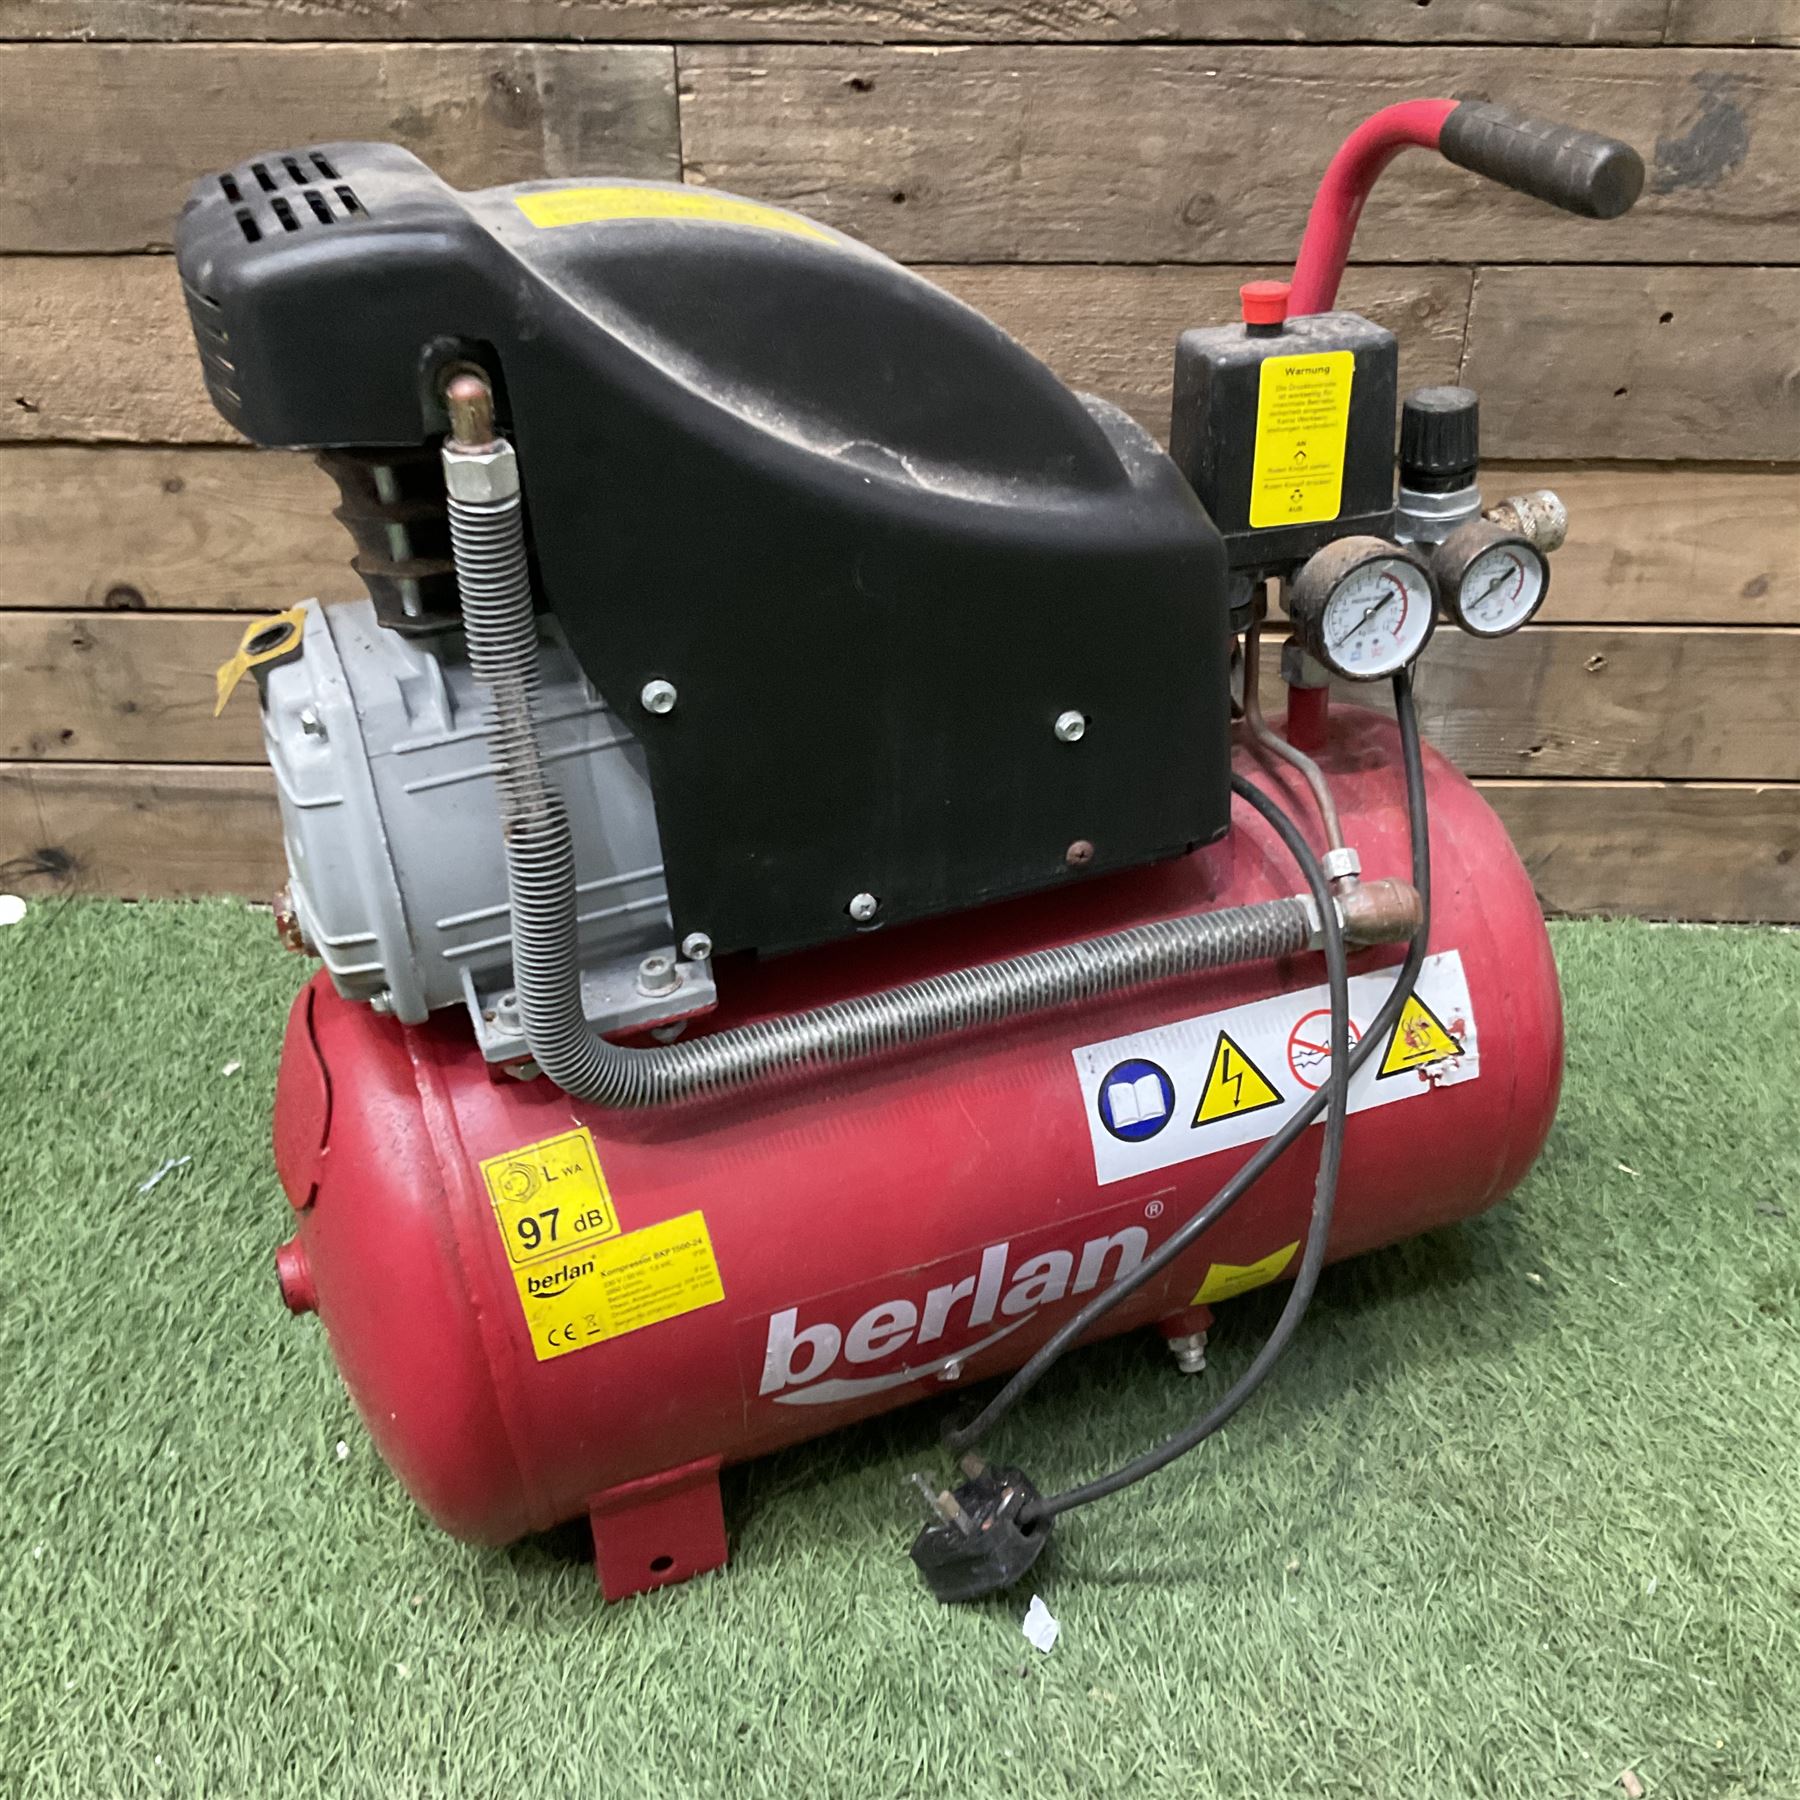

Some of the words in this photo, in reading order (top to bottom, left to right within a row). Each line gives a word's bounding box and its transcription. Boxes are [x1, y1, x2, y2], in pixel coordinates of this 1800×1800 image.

[1285, 366, 1331, 376] Warnung
[542, 1165, 559, 1182] L
[562, 1164, 584, 1177] WA
[517, 1207, 560, 1250] 97
[573, 1209, 604, 1233] dB
[527, 1260, 595, 1294] berlan
[758, 1226, 1150, 1396] berlan
